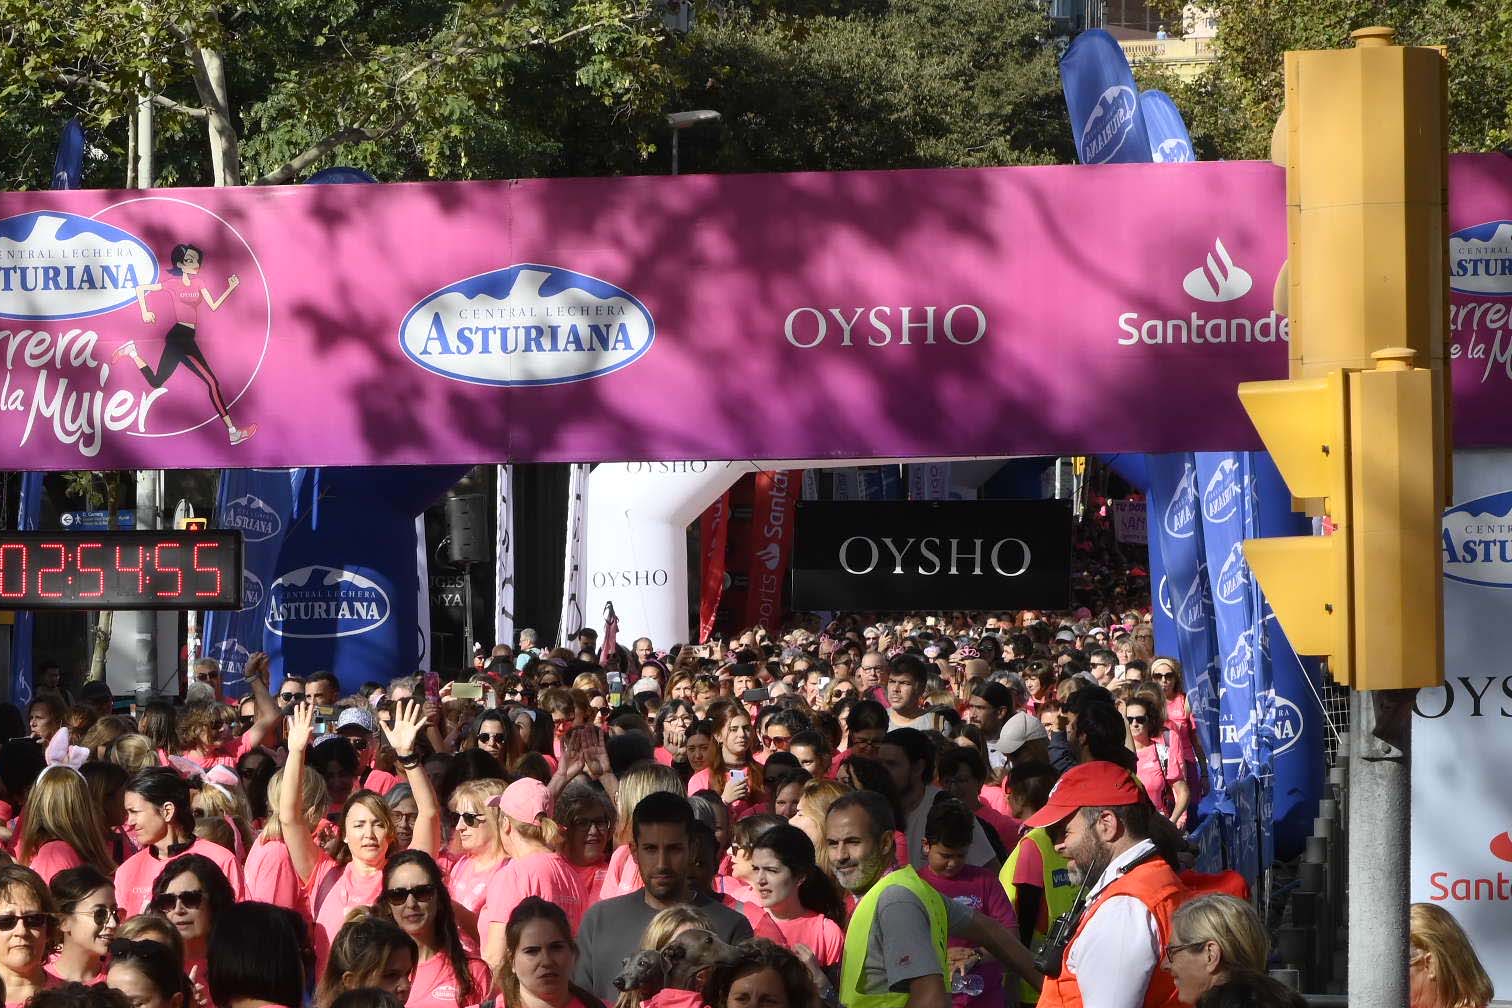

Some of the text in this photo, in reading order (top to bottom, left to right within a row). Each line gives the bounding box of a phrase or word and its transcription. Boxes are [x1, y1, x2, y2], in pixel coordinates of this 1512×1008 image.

[61, 246, 135, 260] LECHERA
[458, 304, 626, 320] CENTRAL LECHERA
[784, 303, 988, 349] OYSHO
[1118, 311, 1289, 345] Santande
[420, 311, 634, 356] ASTURIANA
[0, 373, 25, 412] la
[19, 362, 168, 457] Mujer
[1465, 524, 1512, 535] CENTR
[0, 543, 222, 597] 02:54:55
[838, 536, 1031, 577] OYSHO
[592, 569, 669, 590] OYSHO
[268, 596, 381, 623] ASTURIANA
